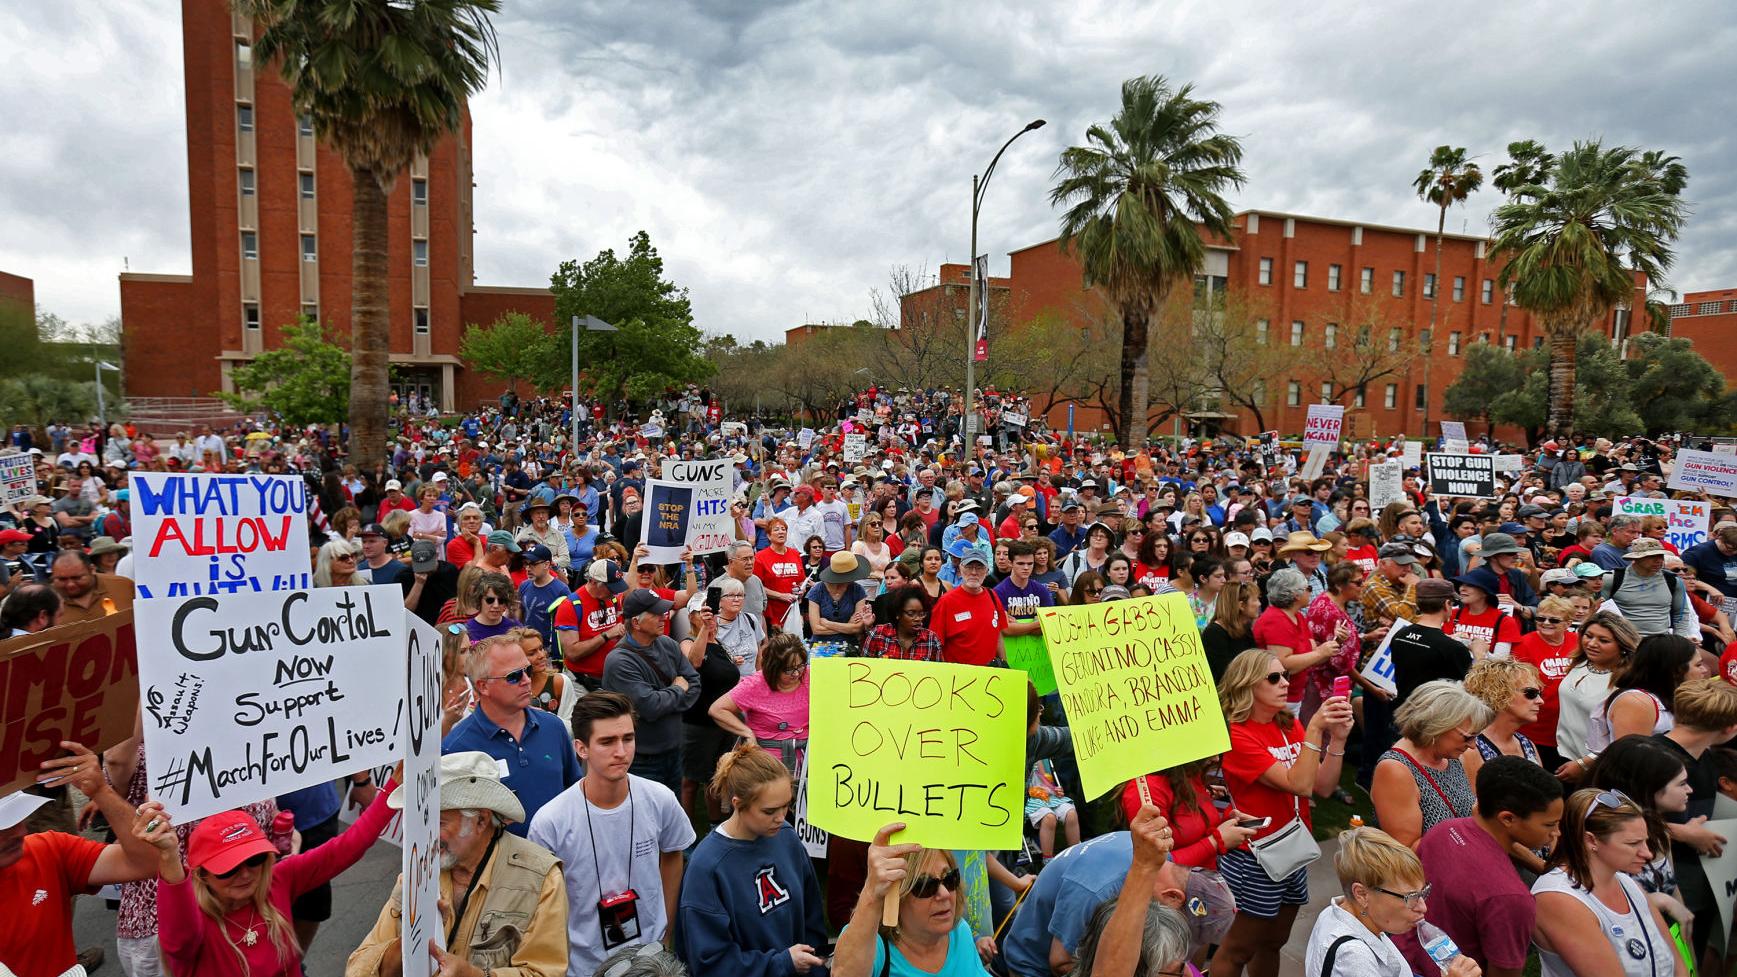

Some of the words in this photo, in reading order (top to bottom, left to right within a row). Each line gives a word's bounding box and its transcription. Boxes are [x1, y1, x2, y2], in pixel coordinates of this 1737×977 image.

[1306, 417, 1341, 430] NEVER
[1304, 431, 1338, 442] AGAIN
[1431, 455, 1463, 468] STOP
[1465, 457, 1491, 469] GUN
[1, 466, 32, 479] LIVES
[672, 464, 725, 482] GUNS
[1434, 468, 1491, 482] VIOLENCE
[1448, 482, 1478, 495] NOW
[134, 476, 248, 516] WHAT
[250, 476, 304, 516] YOU
[658, 503, 684, 511] STOP
[1622, 501, 1665, 515] GRAB
[660, 512, 679, 520] THE
[659, 521, 679, 529] NRA
[703, 522, 718, 530] MY
[149, 516, 292, 557] ALLOW
[1007, 595, 1040, 607] SABINO
[1405, 632, 1422, 640] JAT
[1455, 624, 1494, 636] MARCH
[273, 655, 334, 687] NOW
[408, 629, 441, 756] GUNS
[848, 662, 1004, 718] BOOKS
[234, 681, 345, 727] Support
[1074, 724, 1103, 761] LUKE
[1104, 715, 1139, 744] AND
[1146, 696, 1205, 731] EMMA
[851, 721, 988, 767] OVER
[832, 764, 1010, 827] BULLETS
[797, 818, 826, 845] GUNS
[755, 867, 790, 913] A
